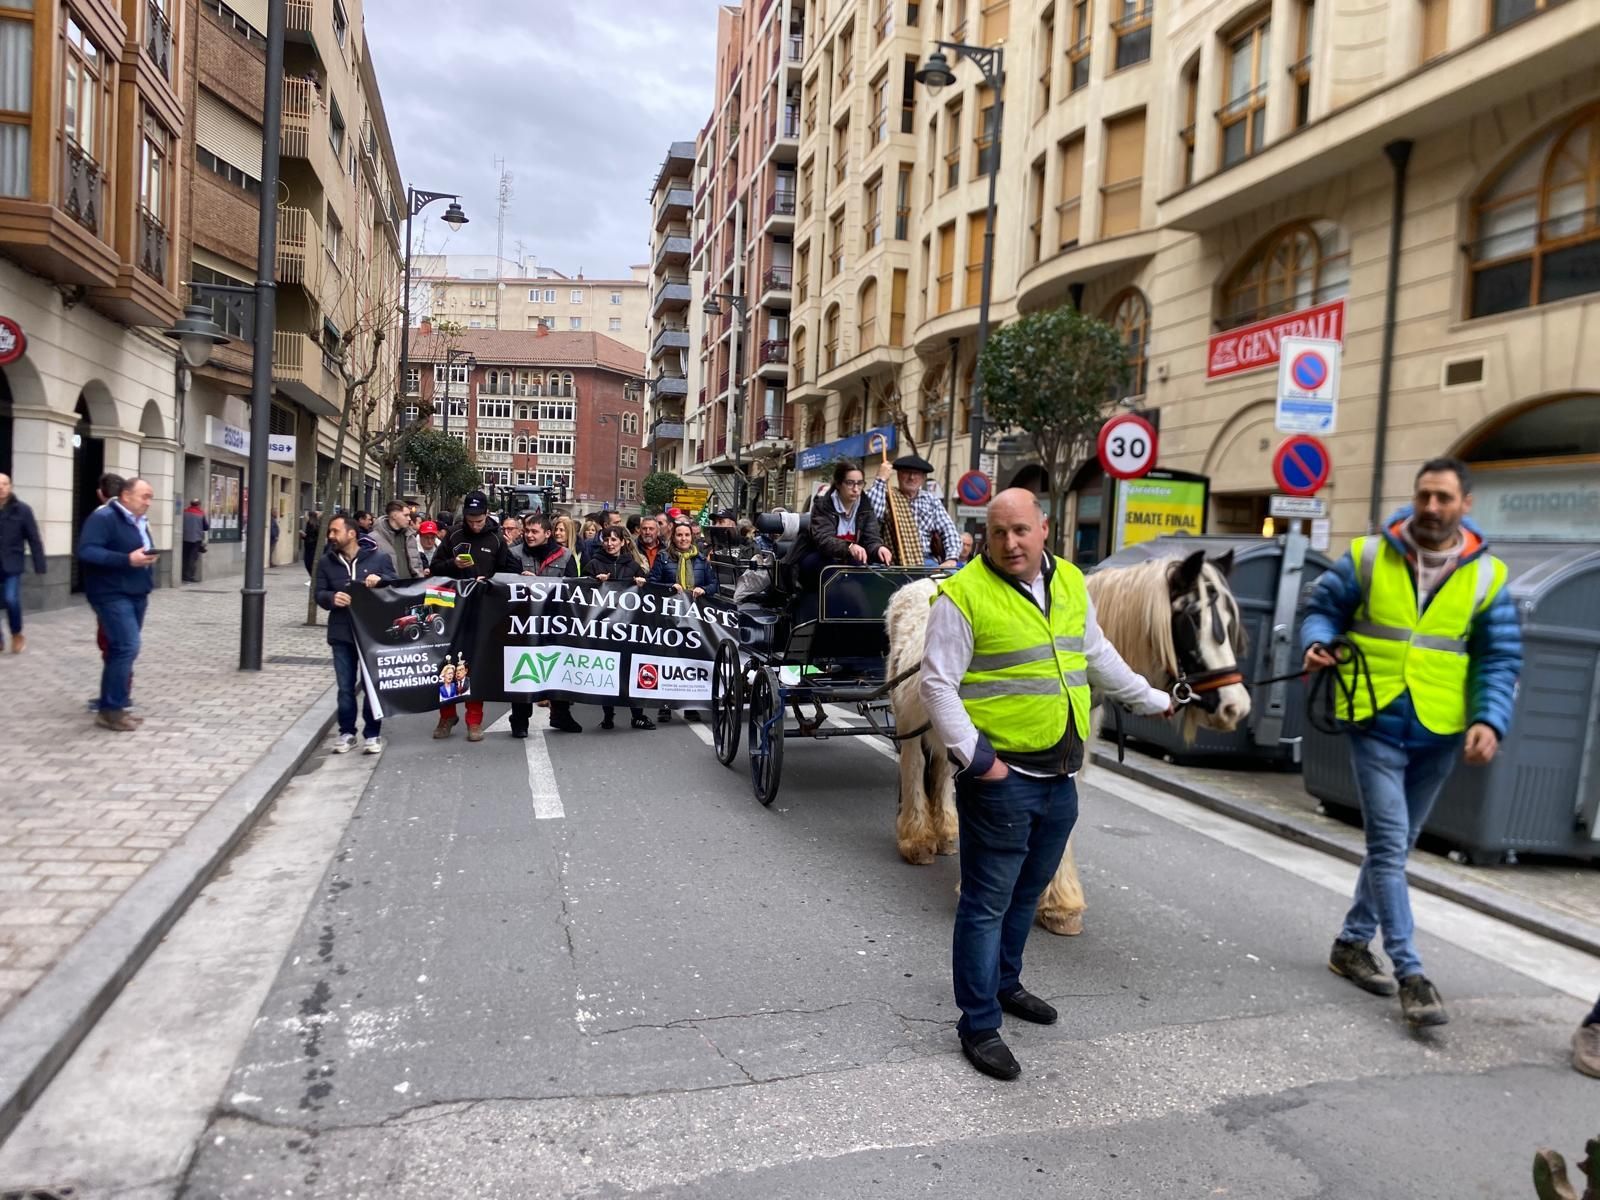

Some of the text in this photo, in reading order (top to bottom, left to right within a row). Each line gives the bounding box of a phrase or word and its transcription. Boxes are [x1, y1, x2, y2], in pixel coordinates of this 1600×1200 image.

[1112, 437, 1146, 458] 30
[1165, 512, 1196, 528] FINAL
[507, 582, 739, 629] ESTAMOS HAST
[507, 615, 702, 649] MISMÍSIMOS
[377, 652, 429, 667] ESTAMOS
[563, 653, 615, 671] ARAG
[378, 663, 438, 678] HASTA LOS
[562, 670, 615, 688] ASAJA
[661, 665, 709, 682] UAGR
[379, 674, 445, 690] MISMÍSIMOS
